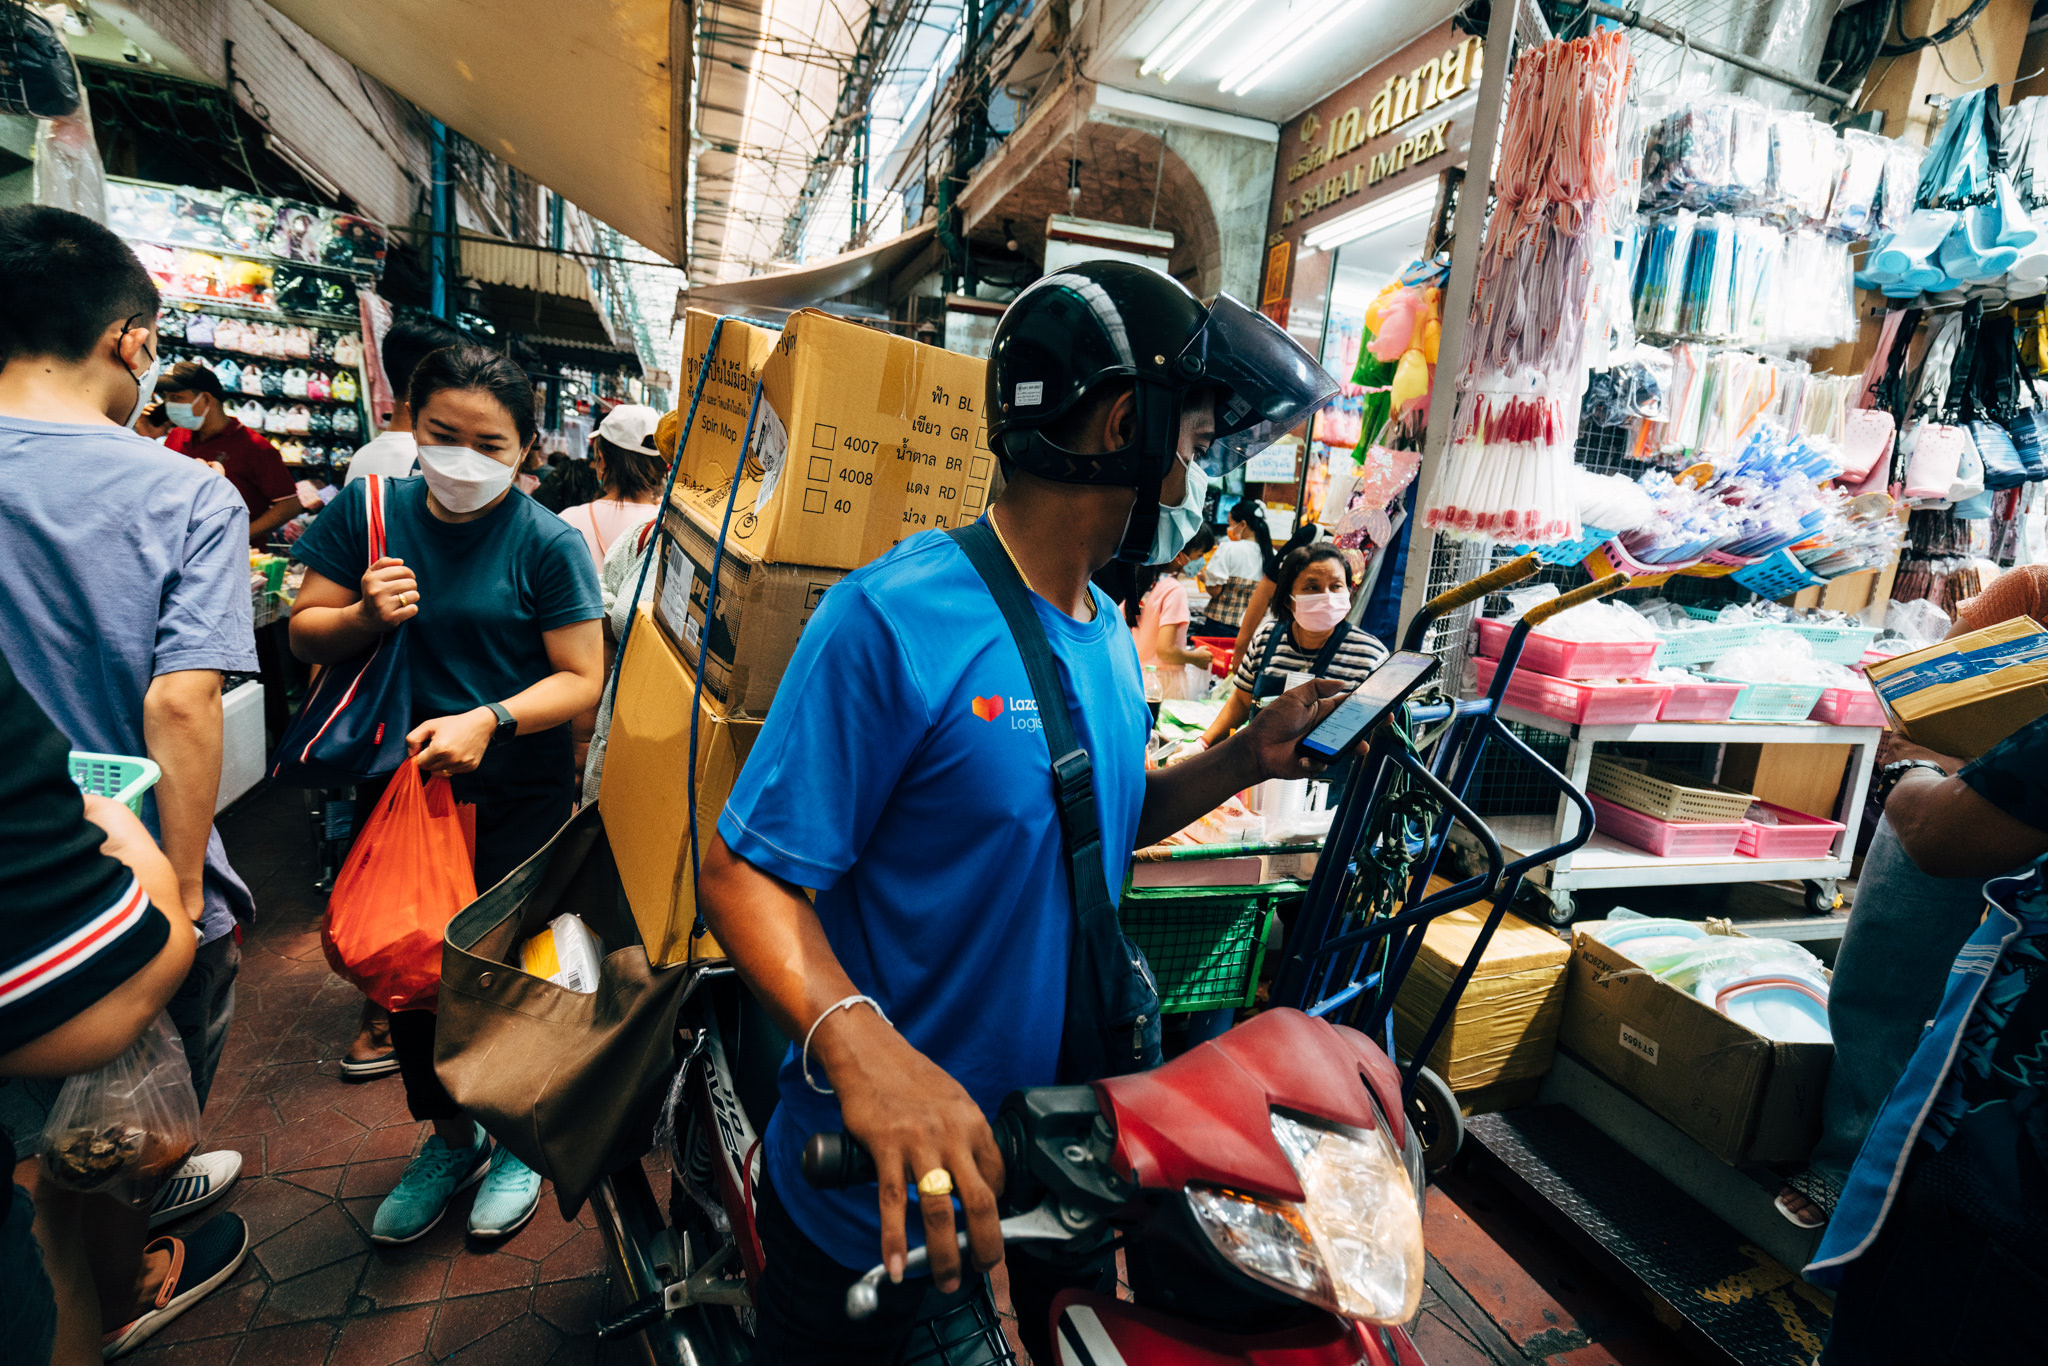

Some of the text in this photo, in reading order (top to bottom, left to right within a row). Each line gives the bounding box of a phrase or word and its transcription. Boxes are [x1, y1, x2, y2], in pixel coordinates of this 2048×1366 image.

[1299, 164, 1364, 219] SAHAI
[1367, 120, 1451, 185] IMPEX
[932, 385, 974, 413] ฟ้า BL
[701, 415, 719, 435] Spin
[720, 422, 738, 445] Mop
[911, 415, 969, 443] เขียว GR
[844, 436, 879, 455] 4007
[896, 437, 963, 472] น้ำตาล BR
[839, 468, 873, 486] 4008
[906, 481, 957, 500] แดง RD
[834, 499, 851, 514] 40
[902, 507, 950, 529] ม่วง PL
[1009, 696, 1039, 712] Laza
[1011, 713, 1043, 733] Logis
[1622, 1032, 1655, 1057] ST1655
[702, 1047, 739, 1153] AVE
[722, 1087, 745, 1137] 110
